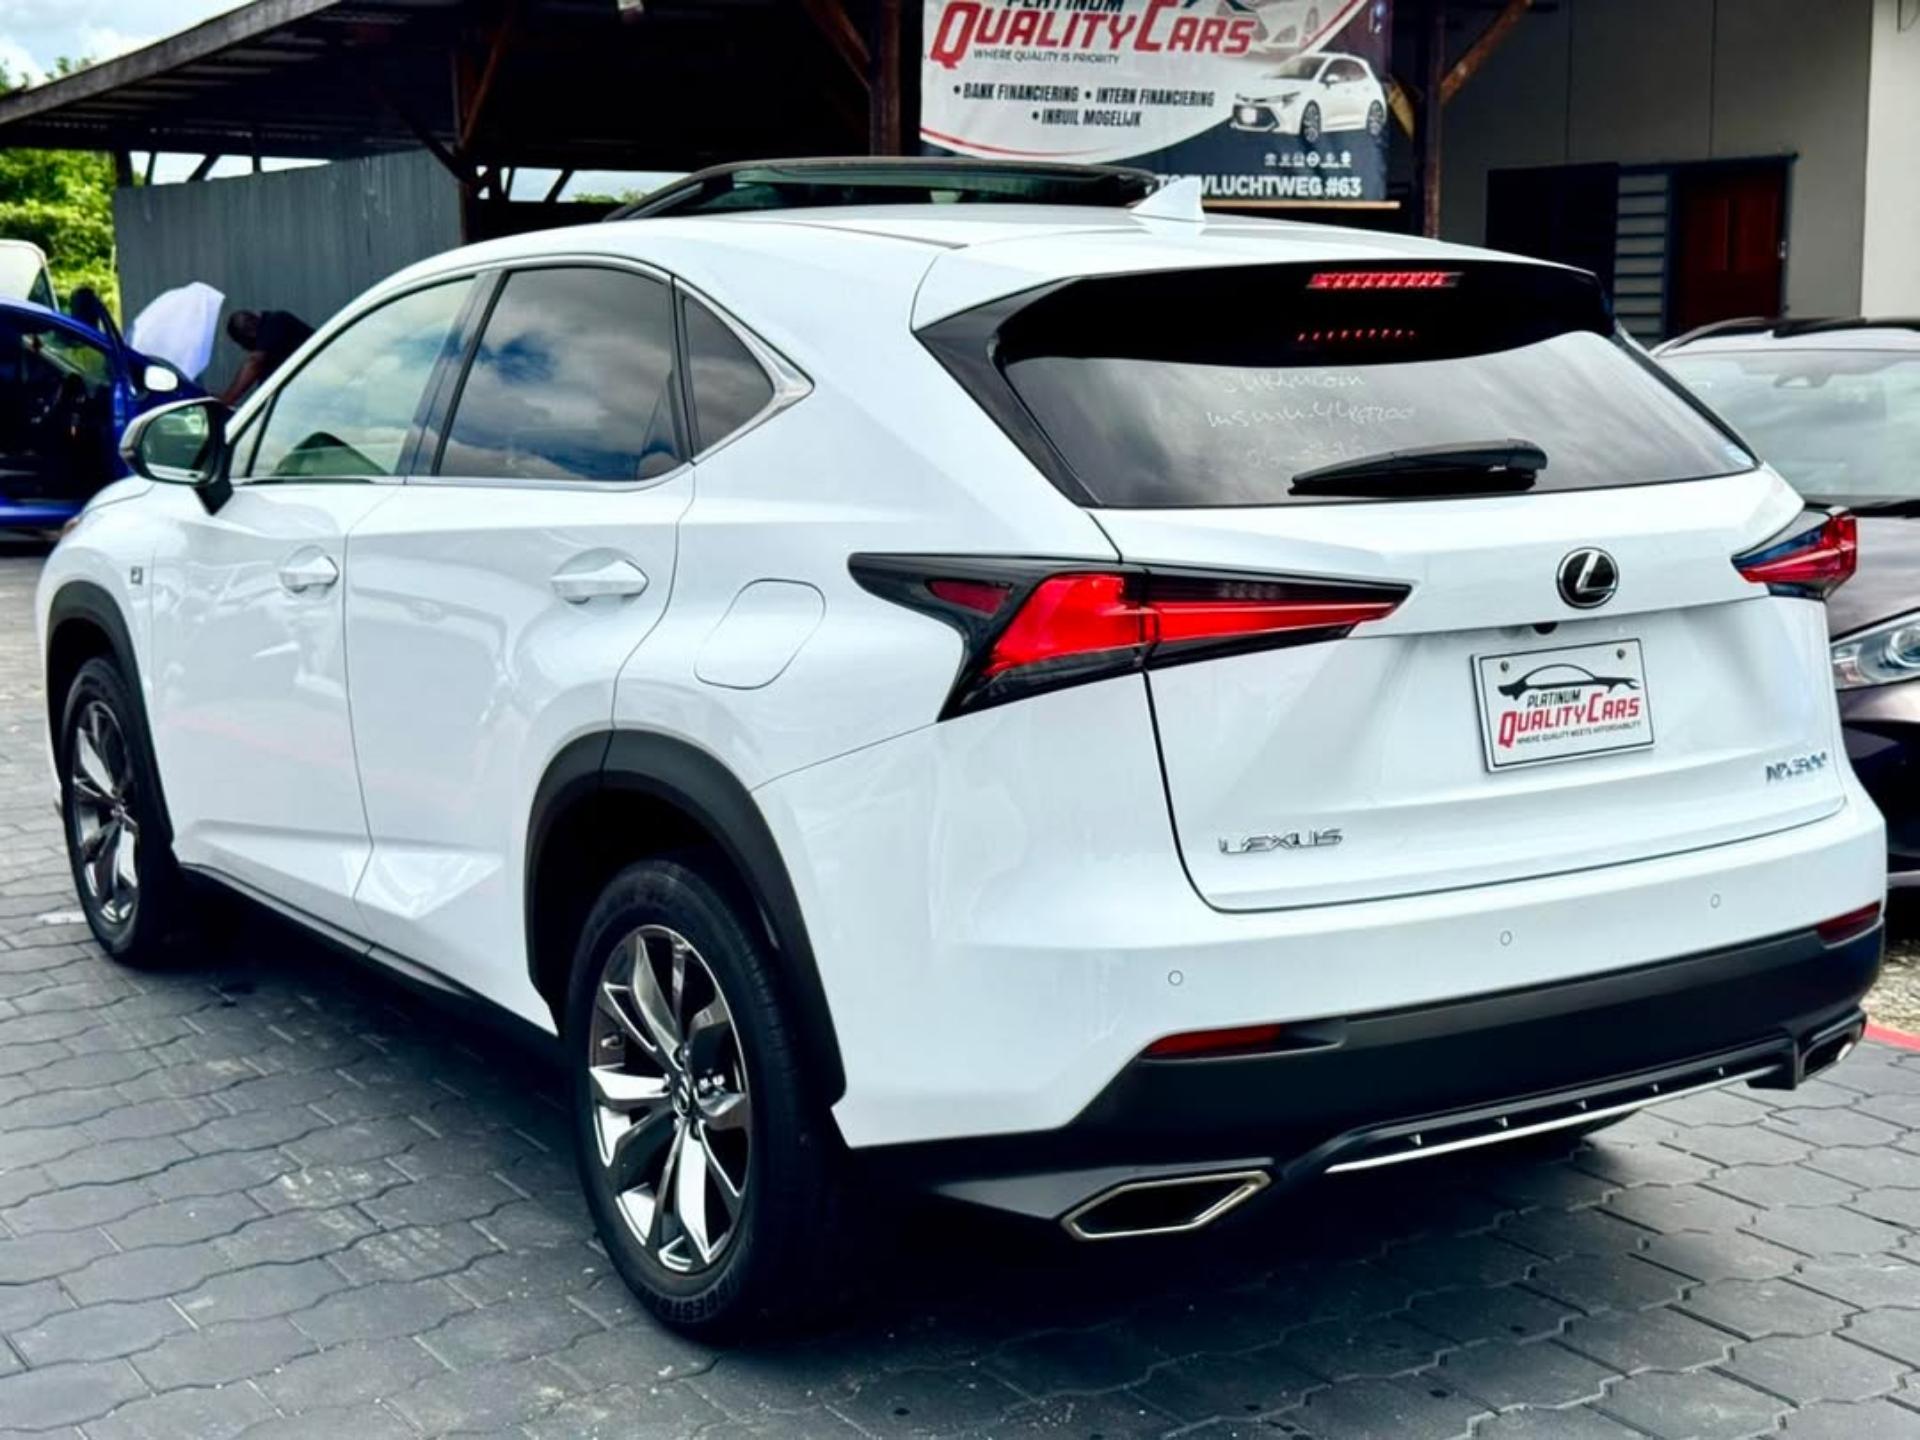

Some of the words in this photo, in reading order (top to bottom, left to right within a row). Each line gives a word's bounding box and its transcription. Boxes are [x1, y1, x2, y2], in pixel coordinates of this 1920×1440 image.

[974, 49, 1011, 60] WHERE
[1014, 50, 1058, 62] QUALITY
[1061, 53, 1070, 62] IS
[1073, 53, 1120, 64] PRIORITY
[963, 83, 994, 99] BANK
[1000, 84, 1079, 102] FINANCIERING
[1096, 88, 1136, 104] INTERN
[1139, 91, 1215, 107] FINANCIERING
[1041, 109, 1079, 125] INRUIL
[1083, 110, 1142, 126] MOGELIJK
[1154, 173, 1322, 196] TVLUCHTWEG
[1325, 176, 1362, 197] #63
[1527, 689, 1581, 708] PLATINUM
[1218, 828, 1343, 854] LEXUS
